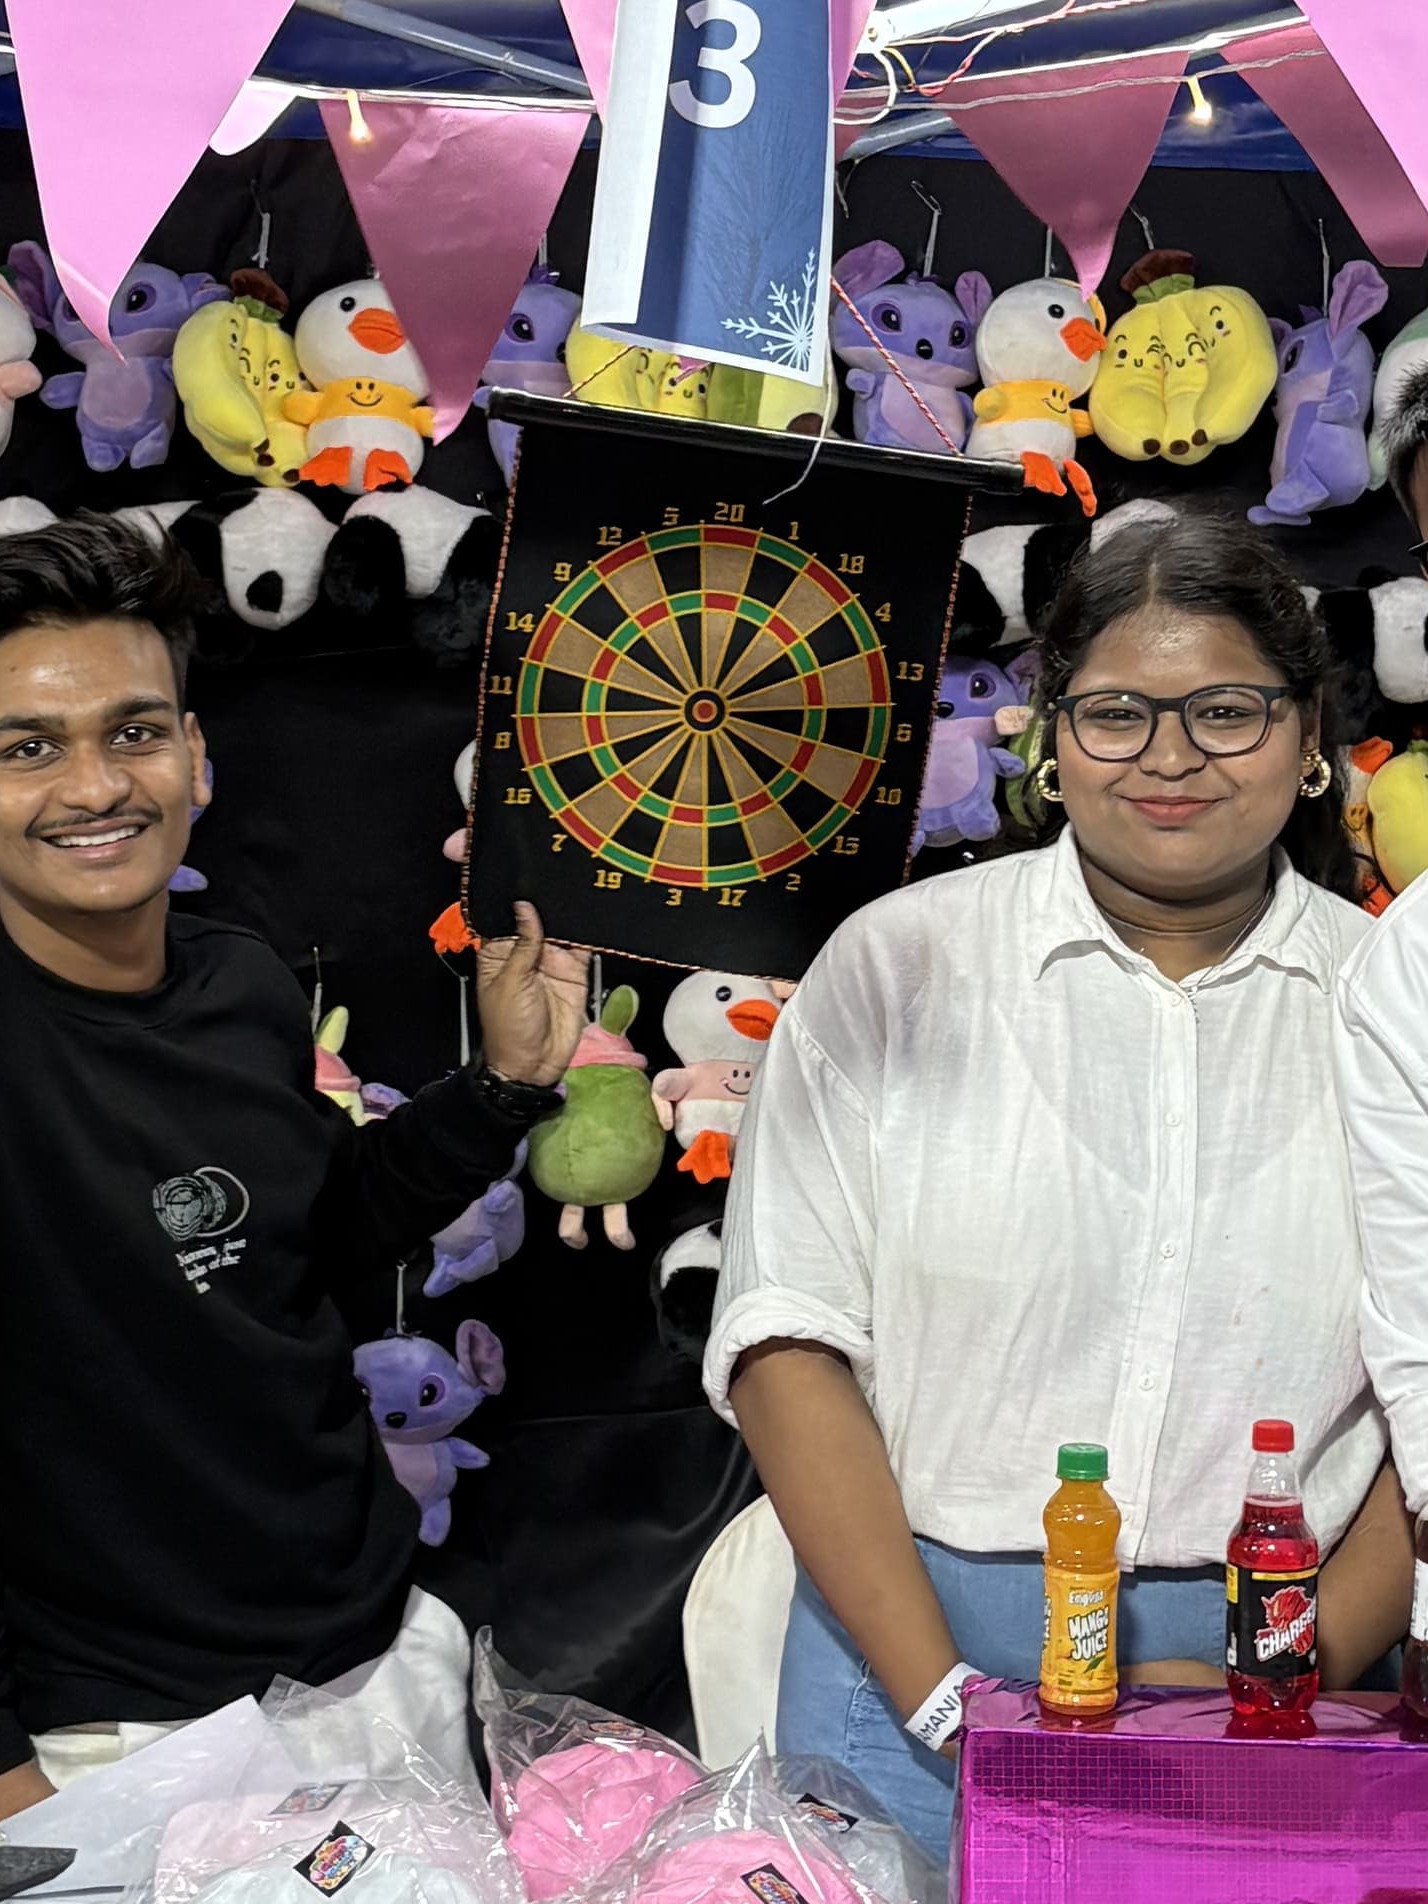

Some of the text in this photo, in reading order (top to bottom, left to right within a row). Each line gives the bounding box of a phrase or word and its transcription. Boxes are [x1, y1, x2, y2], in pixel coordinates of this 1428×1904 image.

[663, 508, 678, 524] 5
[715, 503, 744, 522] 20
[597, 526, 621, 545] 12
[789, 522, 798, 540] 1
[554, 563, 570, 582] 9
[838, 554, 864, 574] 18
[876, 603, 891, 621] 4
[506, 613, 535, 631] 14
[897, 663, 923, 682] 13
[489, 677, 512, 694] 11
[495, 732, 511, 748] 8
[552, 835, 567, 851] 7
[834, 836, 859, 854] 15
[594, 870, 621, 889] 19
[786, 874, 801, 890] 2
[666, 890, 682, 906] 3
[718, 889, 745, 907] 17
[1072, 1628, 1107, 1660] JUICE
